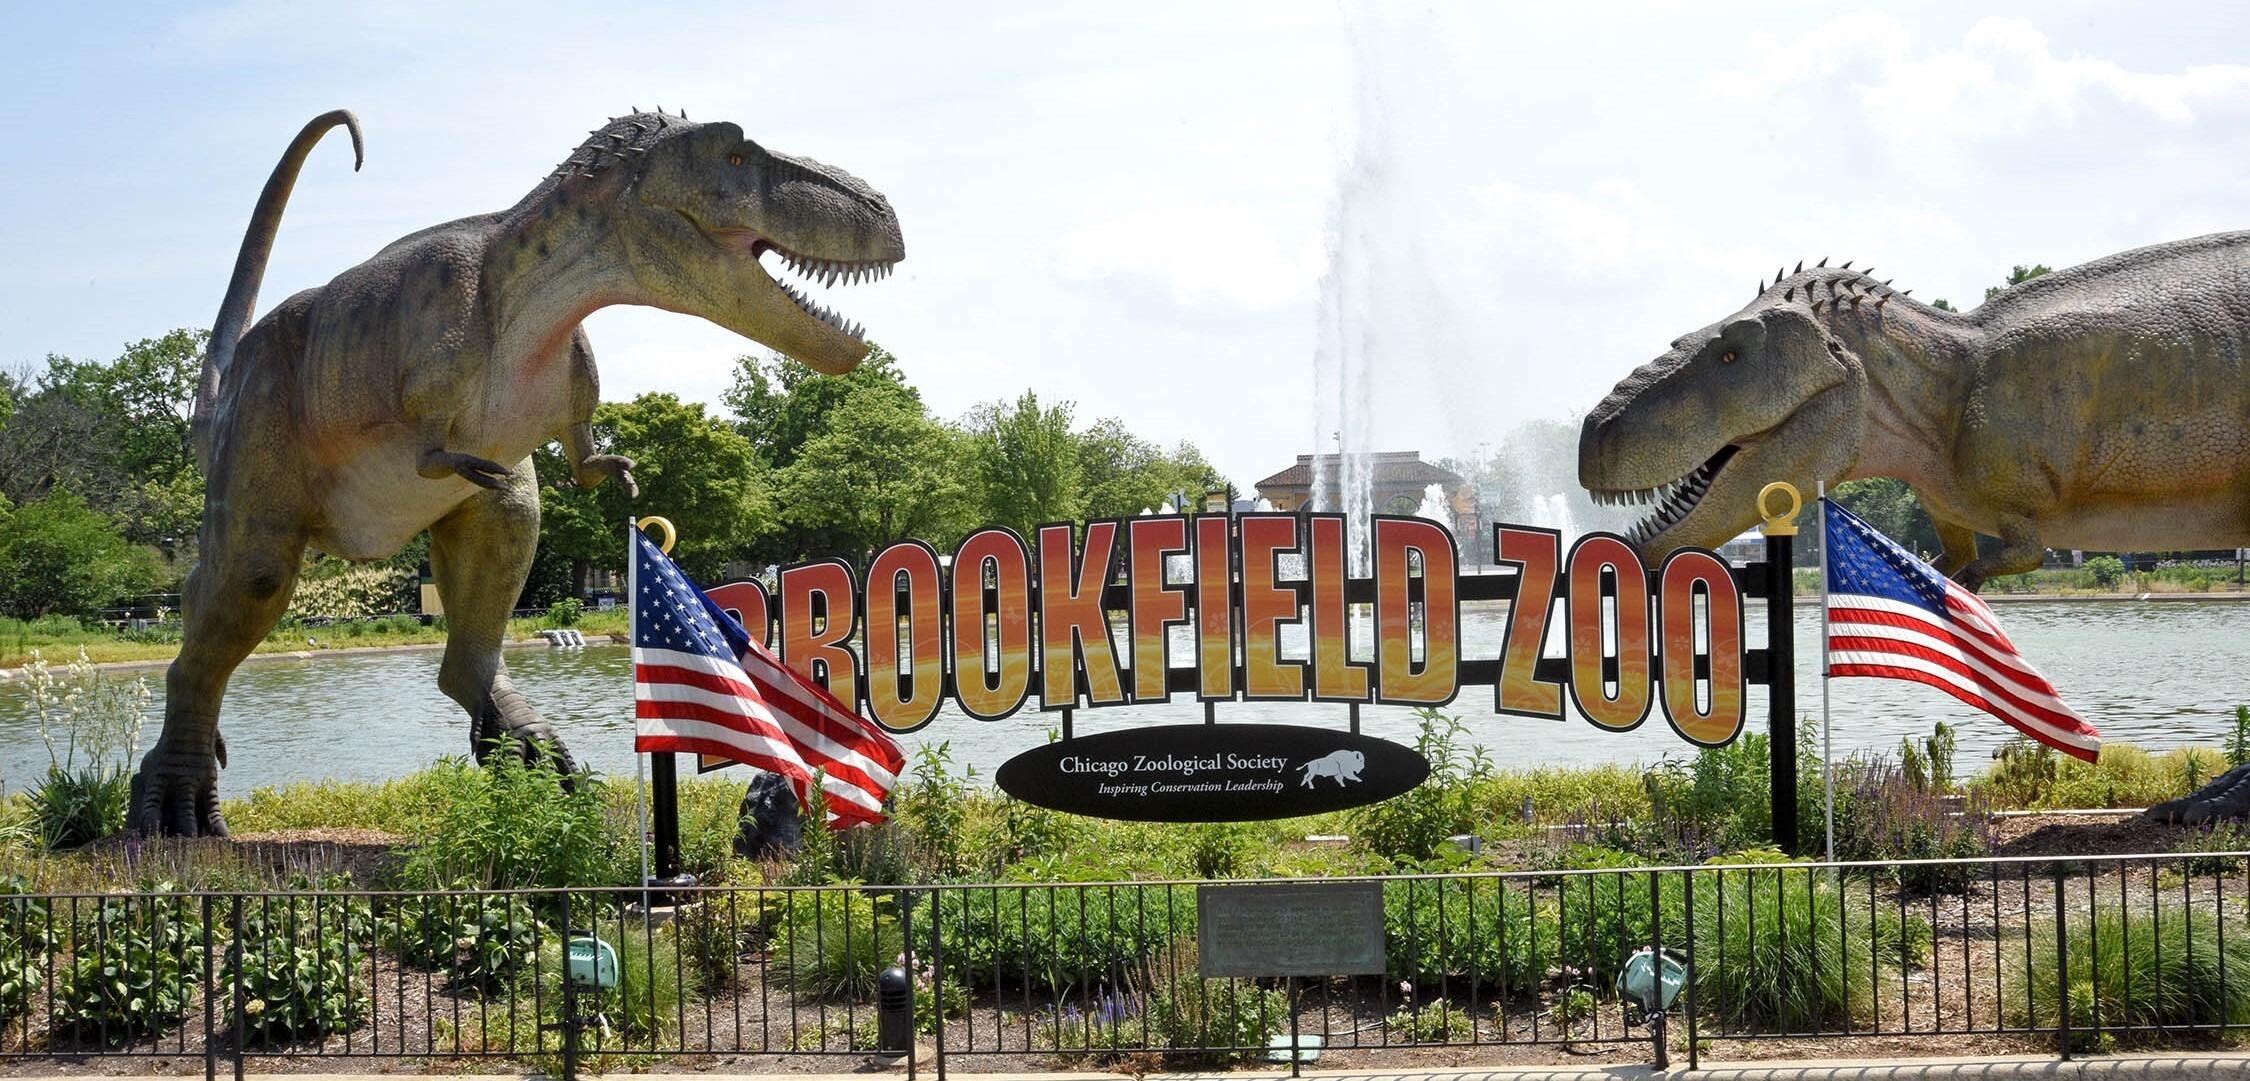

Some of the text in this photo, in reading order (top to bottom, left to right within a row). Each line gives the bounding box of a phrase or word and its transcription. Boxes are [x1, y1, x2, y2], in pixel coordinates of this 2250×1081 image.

[1494, 523, 1746, 748] ZOO
[1059, 753, 1288, 778] Chicago Zoological Society
[1098, 779, 1284, 797] Inspiring Conservation Leadership
